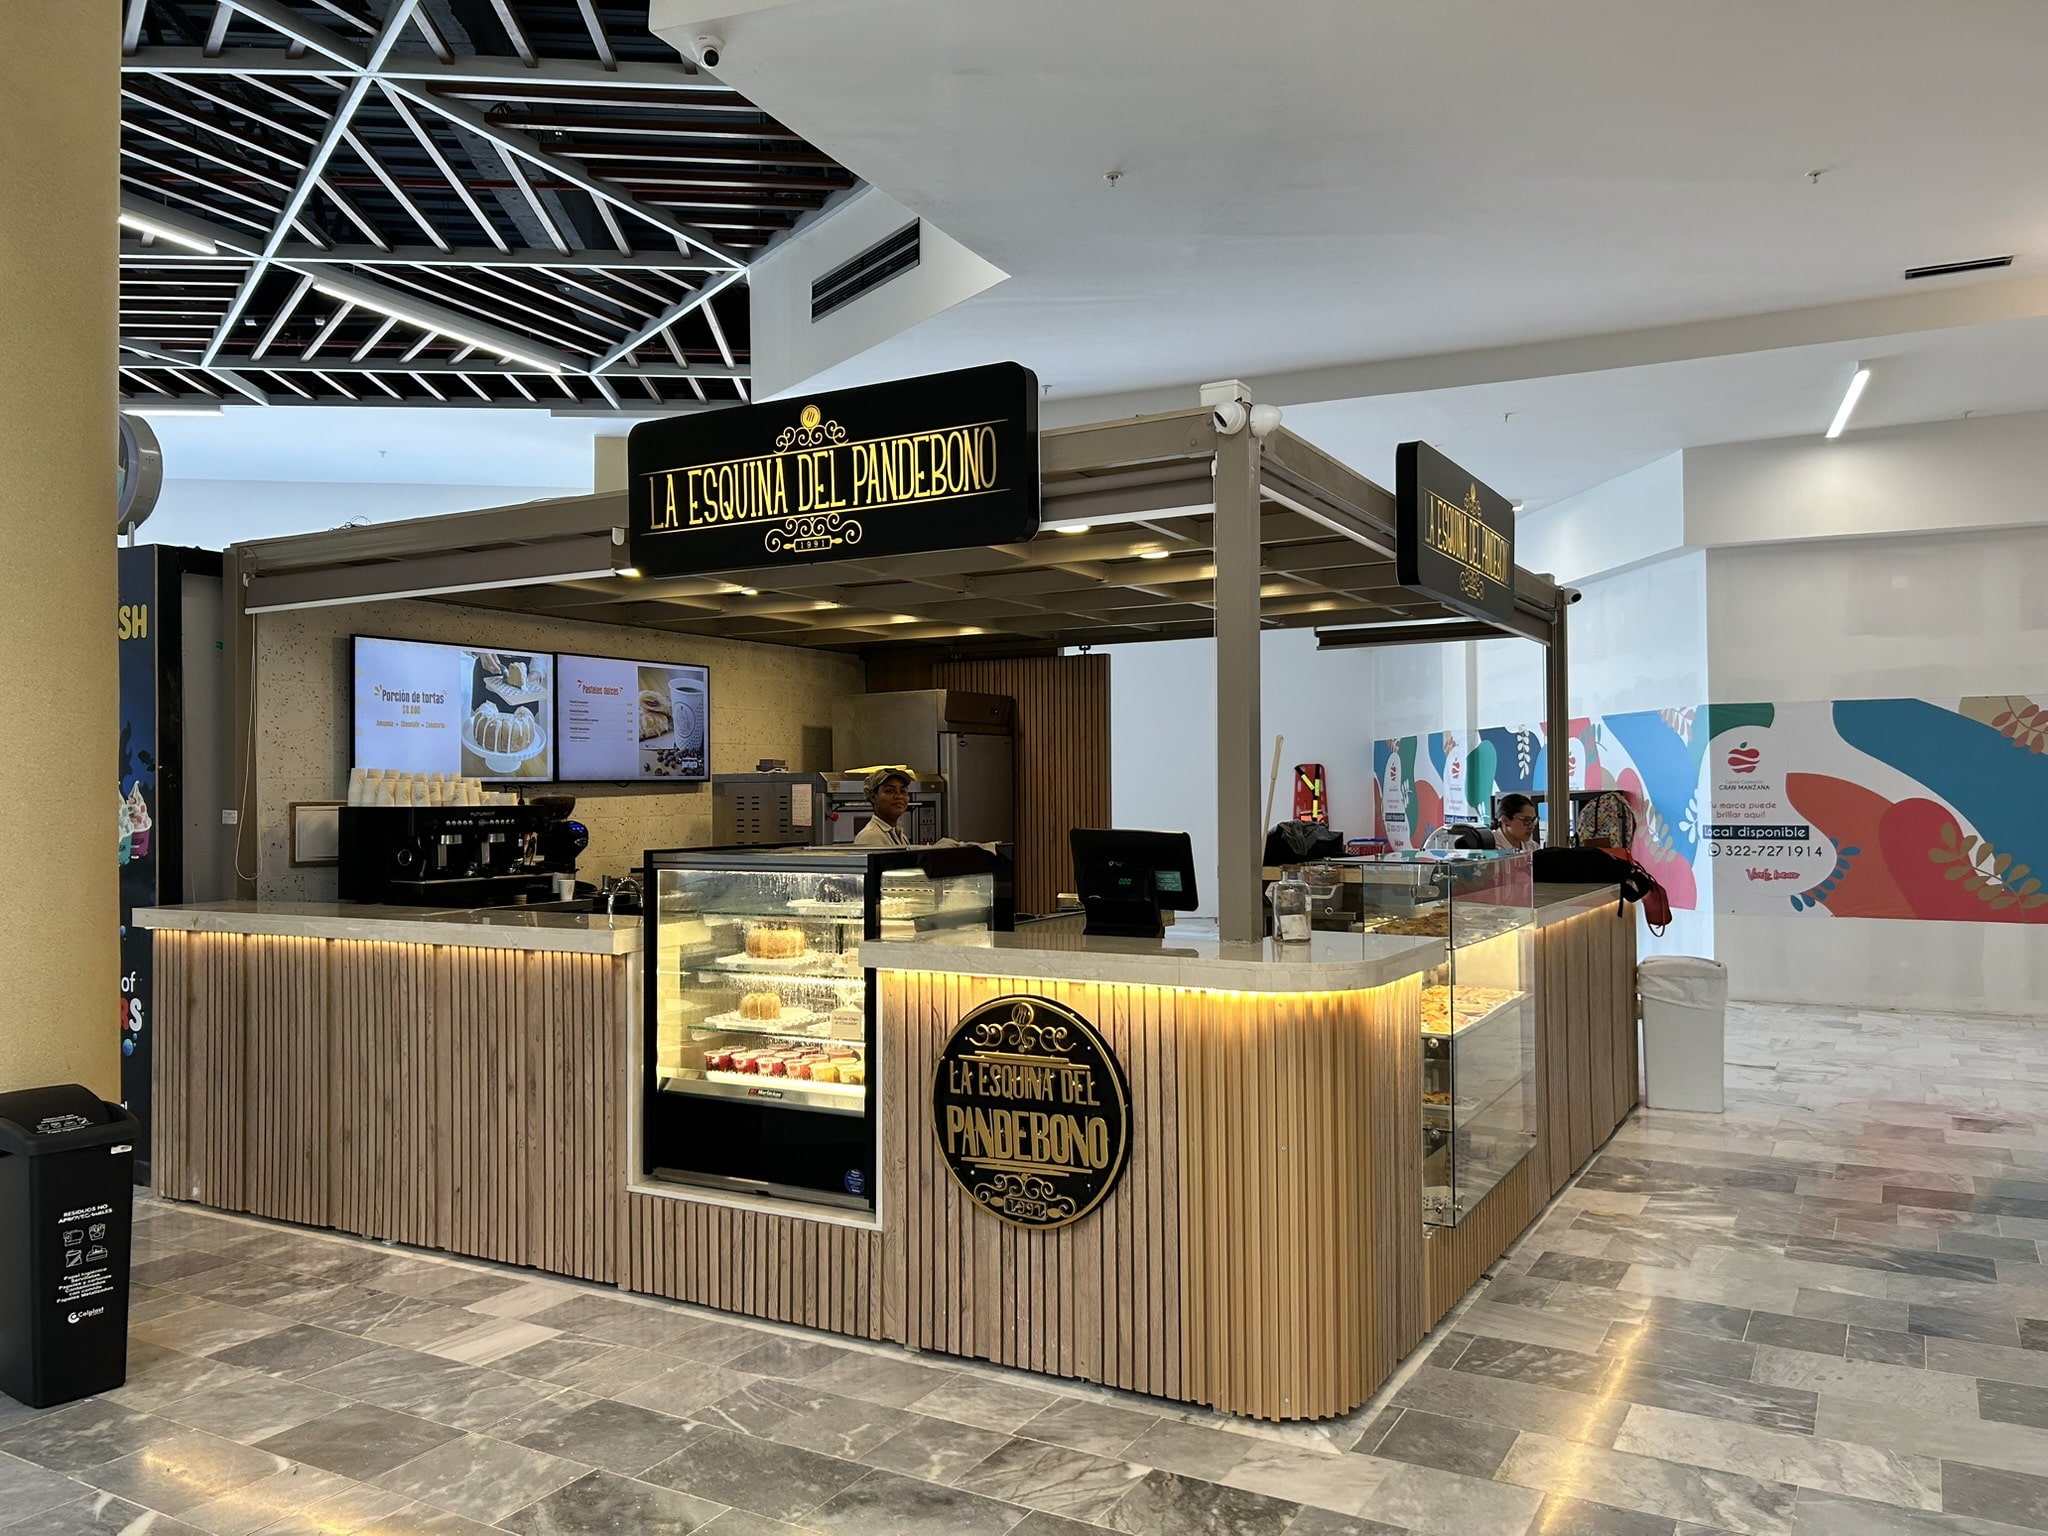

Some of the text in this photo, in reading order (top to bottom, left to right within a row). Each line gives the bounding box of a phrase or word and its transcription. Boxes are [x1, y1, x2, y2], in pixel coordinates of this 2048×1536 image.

[649, 425, 997, 529] LA ESQUINA DEL PANDEBONO
[1424, 492, 1435, 545] LA
[800, 539, 825, 549] 1991
[382, 689, 445, 704] Porción de tortas
[1748, 801, 1777, 810] puede
[1716, 810, 1741, 819] brillar
[1737, 826, 1806, 839] disponible
[1725, 845, 1823, 857] 322-7271914
[121, 971, 137, 993] of
[949, 1060, 1100, 1106] LA ESQUINA DEL
[946, 1105, 1109, 1169] PANDEBONO
